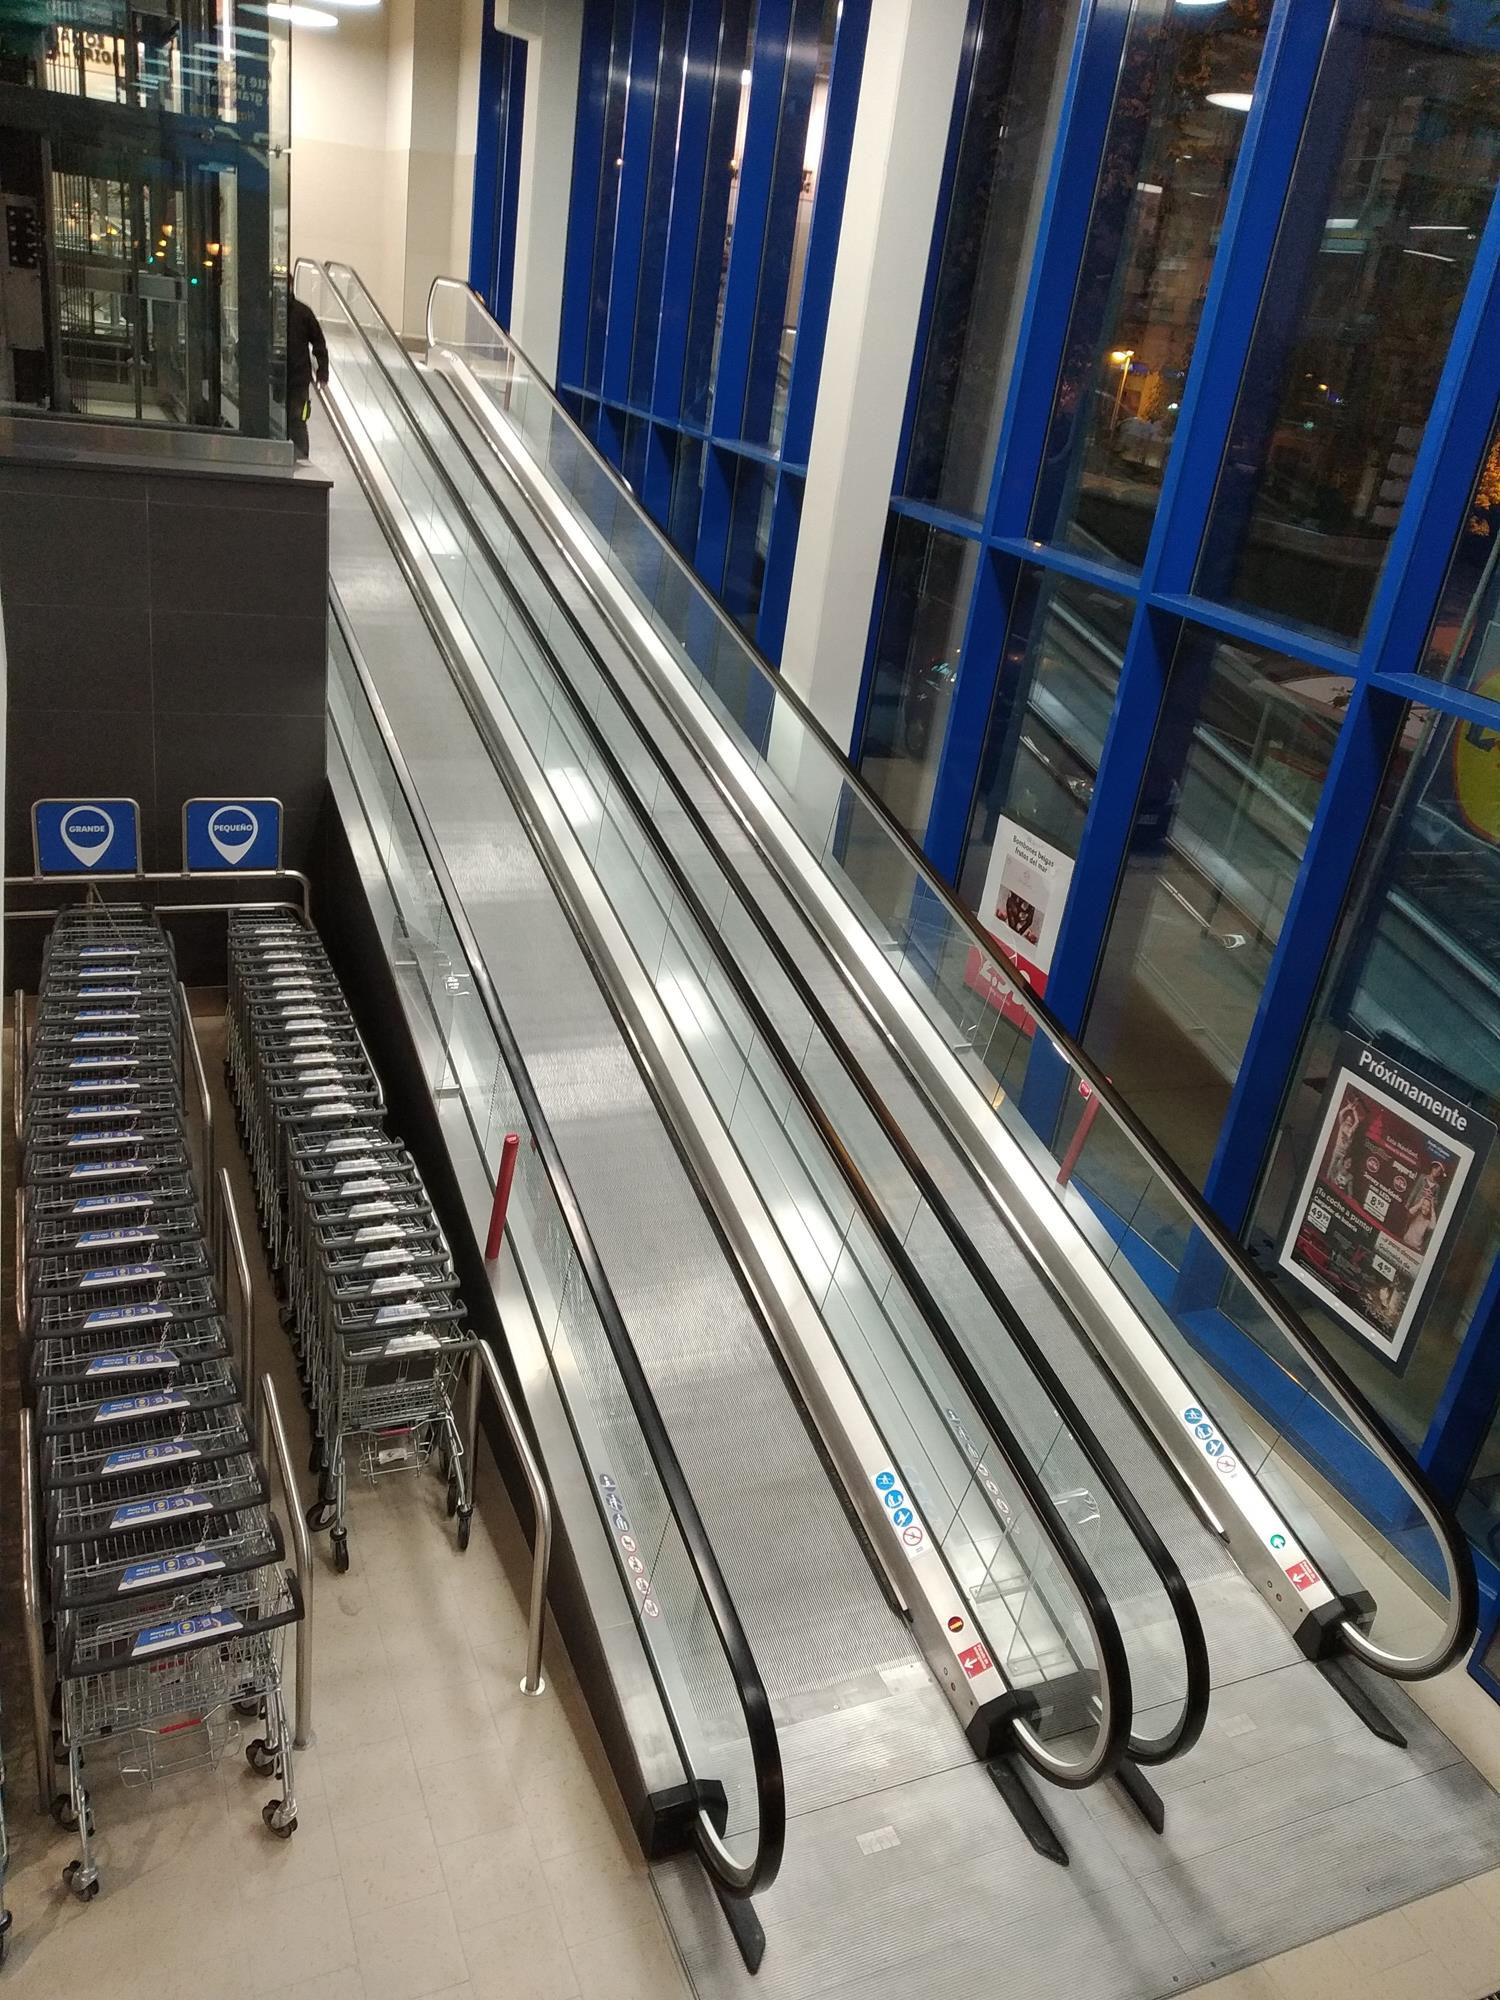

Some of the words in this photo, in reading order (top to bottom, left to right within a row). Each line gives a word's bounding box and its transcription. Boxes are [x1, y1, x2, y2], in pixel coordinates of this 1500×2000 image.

[68, 824, 106, 834] GRANDE
[213, 823, 253, 834] PEQUEÑO
[1012, 834, 1038, 856] Bombones
[1037, 851, 1055, 867] belgas
[1013, 846, 1029, 861] frutos
[1028, 856, 1038, 867] del
[1037, 863, 1047, 873] mar
[1358, 1049, 1468, 1132] Próximamente
[1325, 1193, 1346, 1213] coche
[1350, 1213, 1373, 1234] punto!
